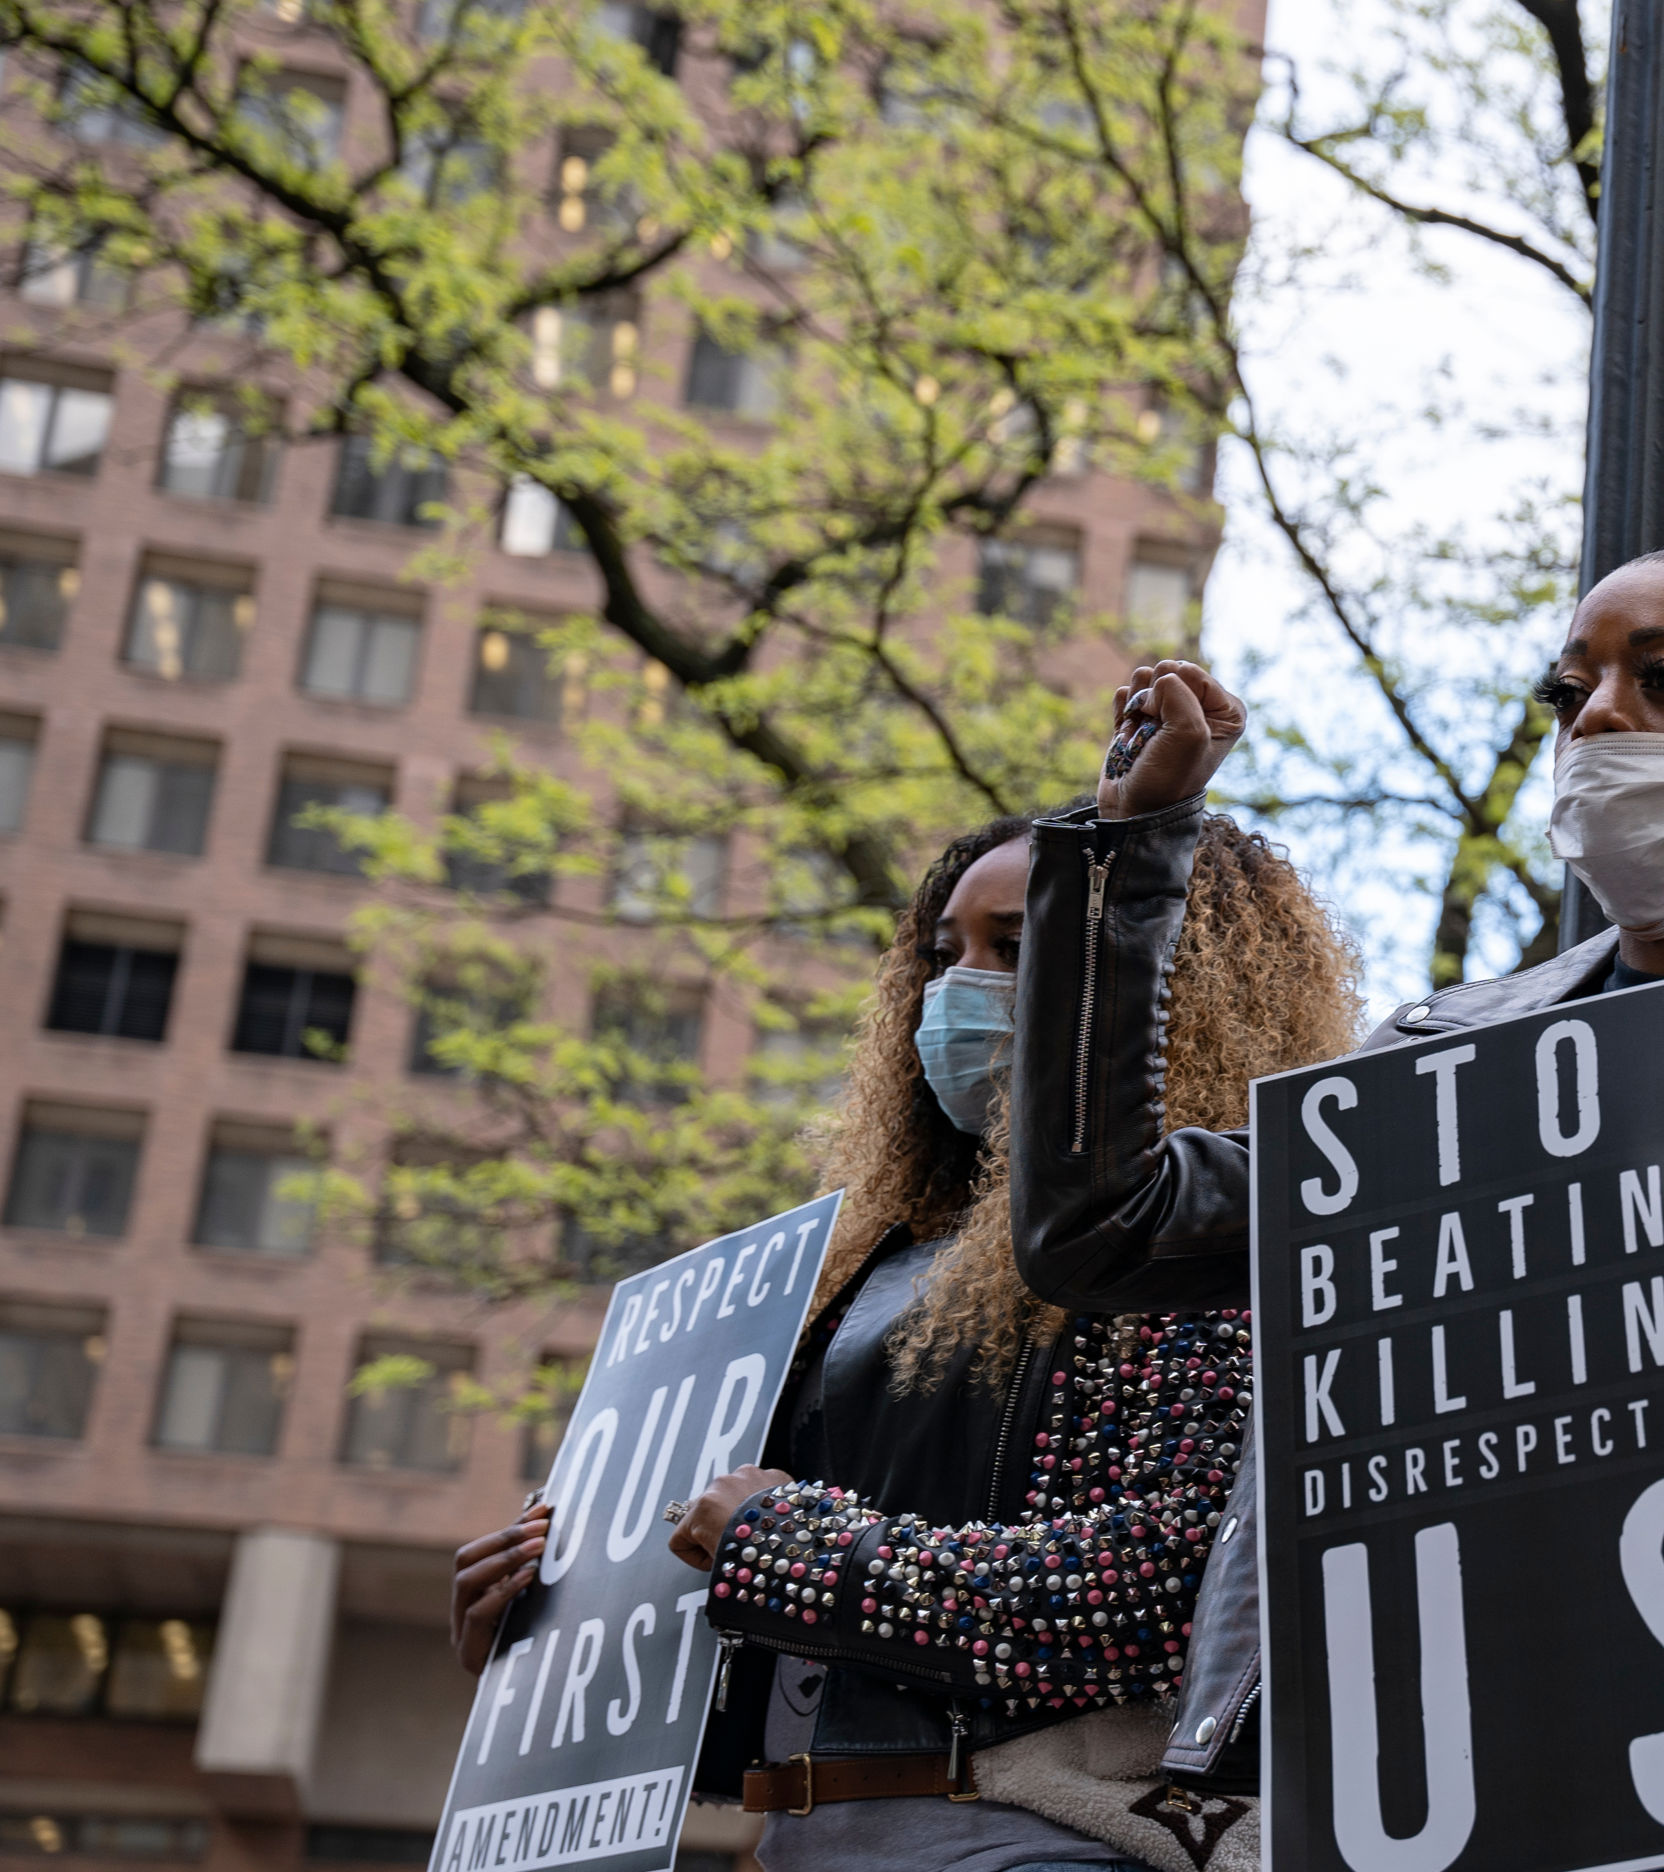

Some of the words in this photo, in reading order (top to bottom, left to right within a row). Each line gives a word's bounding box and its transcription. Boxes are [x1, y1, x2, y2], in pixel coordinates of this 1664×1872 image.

[606, 1218, 820, 1368] RESPECT
[540, 1353, 767, 1586] OUR
[476, 1588, 709, 1766] FIRST
[447, 1778, 674, 1872] AMENDMENT!
